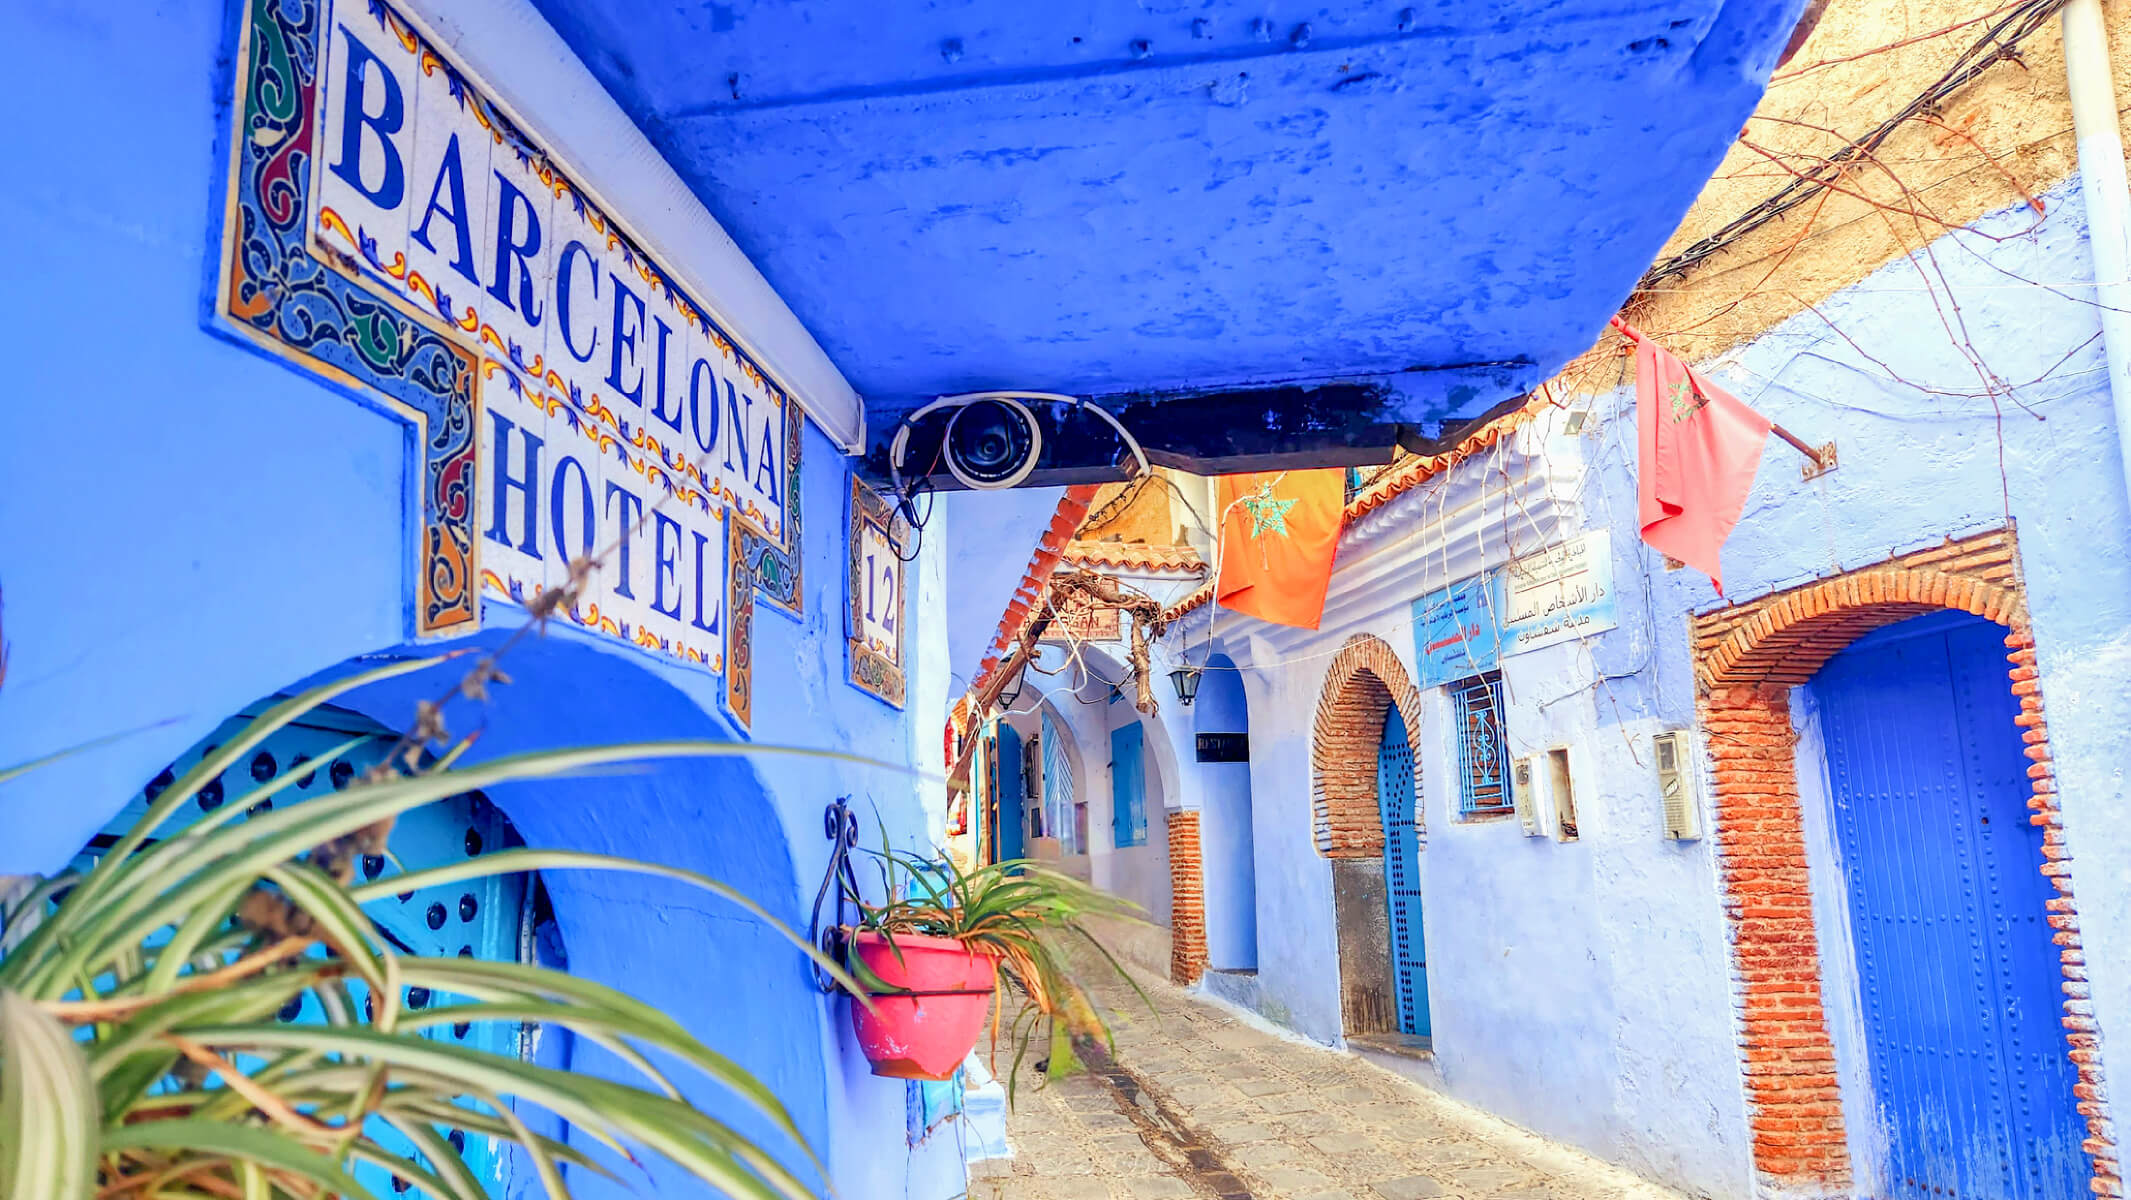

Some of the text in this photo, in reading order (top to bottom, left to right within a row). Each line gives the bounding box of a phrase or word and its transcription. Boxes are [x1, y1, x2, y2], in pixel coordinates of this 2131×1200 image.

[328, 24, 780, 508] BARCELONA
[483, 407, 720, 636] HOTEL
[865, 553, 895, 635] 12
[1590, 582, 1606, 603] دار
